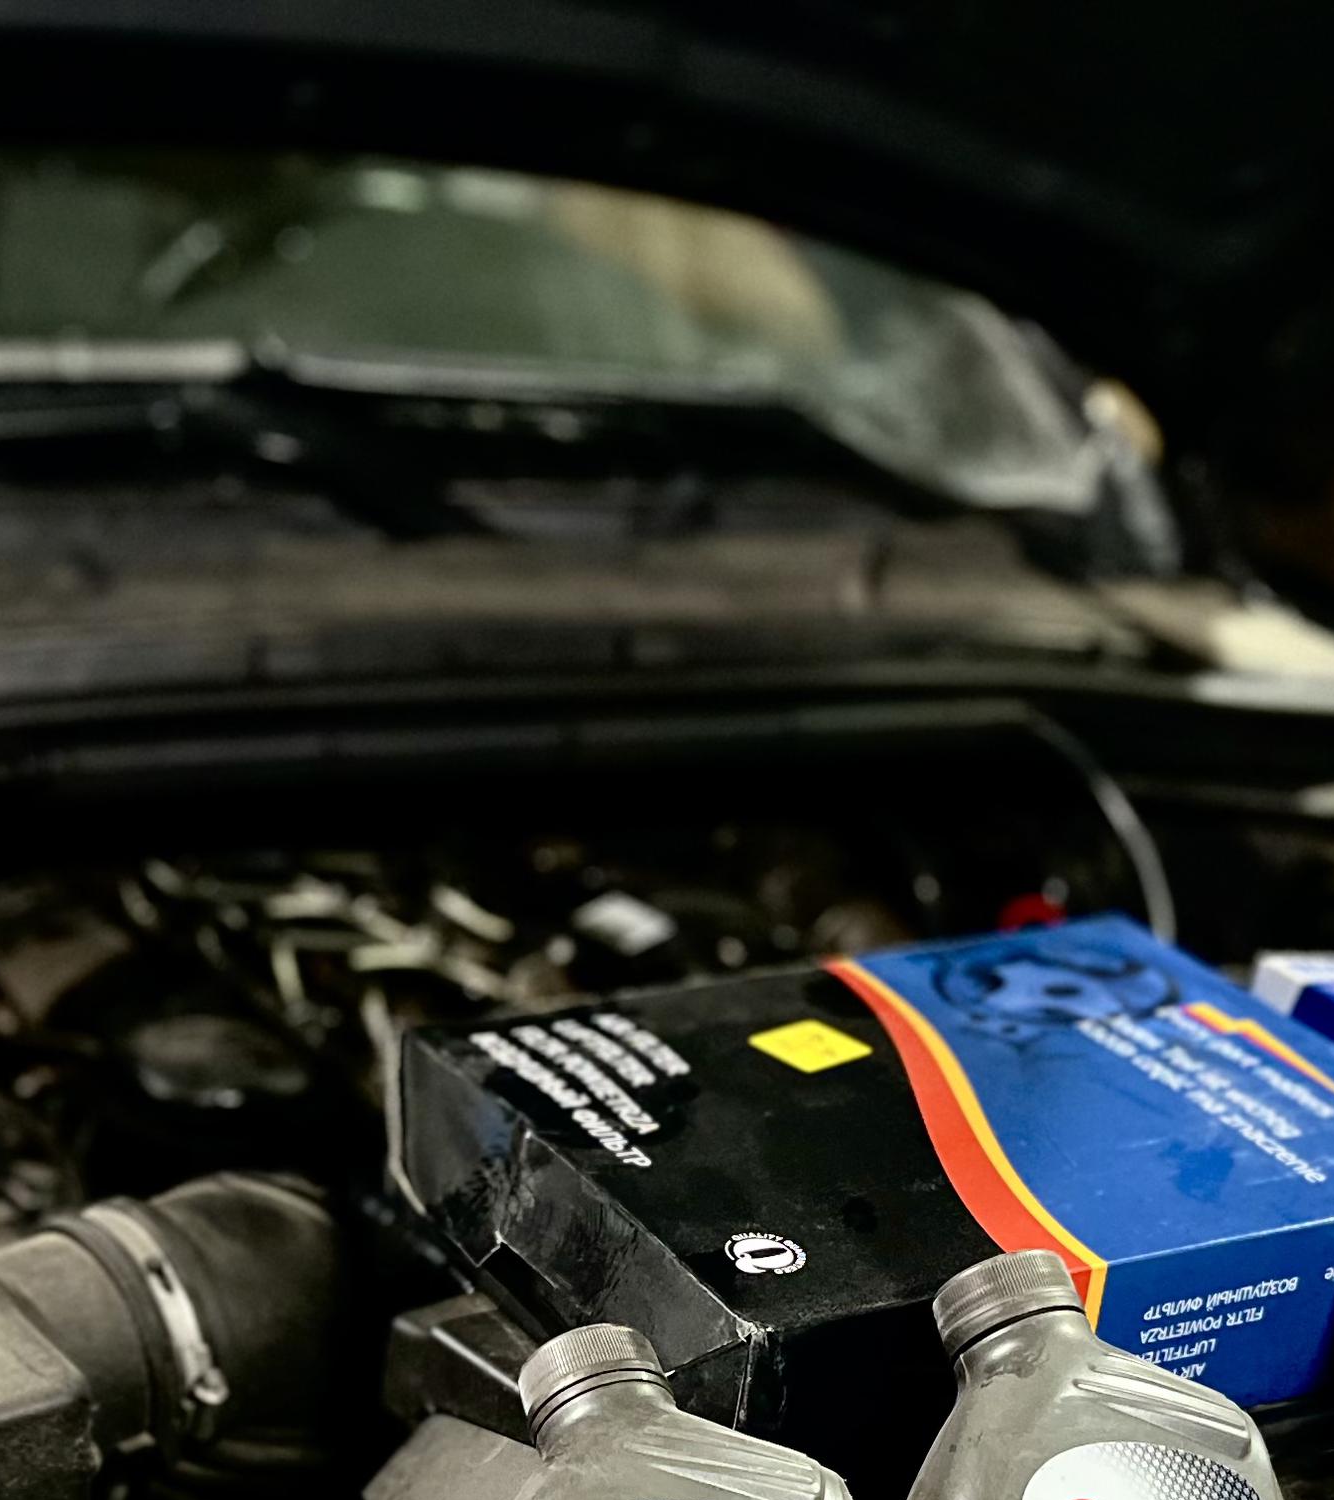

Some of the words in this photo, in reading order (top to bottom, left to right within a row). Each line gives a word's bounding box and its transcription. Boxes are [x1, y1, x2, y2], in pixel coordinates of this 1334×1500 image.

[571, 1108, 654, 1169] ФИЛЬТР
[1219, 1112, 1327, 1184] znaczenie
[731, 1231, 785, 1243] QUALITY
[1205, 1275, 1300, 1313] ВОЗДУШНЫЙ
[1142, 1298, 1203, 1322] ФИЛЬТР
[1225, 1305, 1266, 1328] FILTR
[1139, 1315, 1223, 1345] POWIETRZA
[1180, 1361, 1207, 1379] AIR
